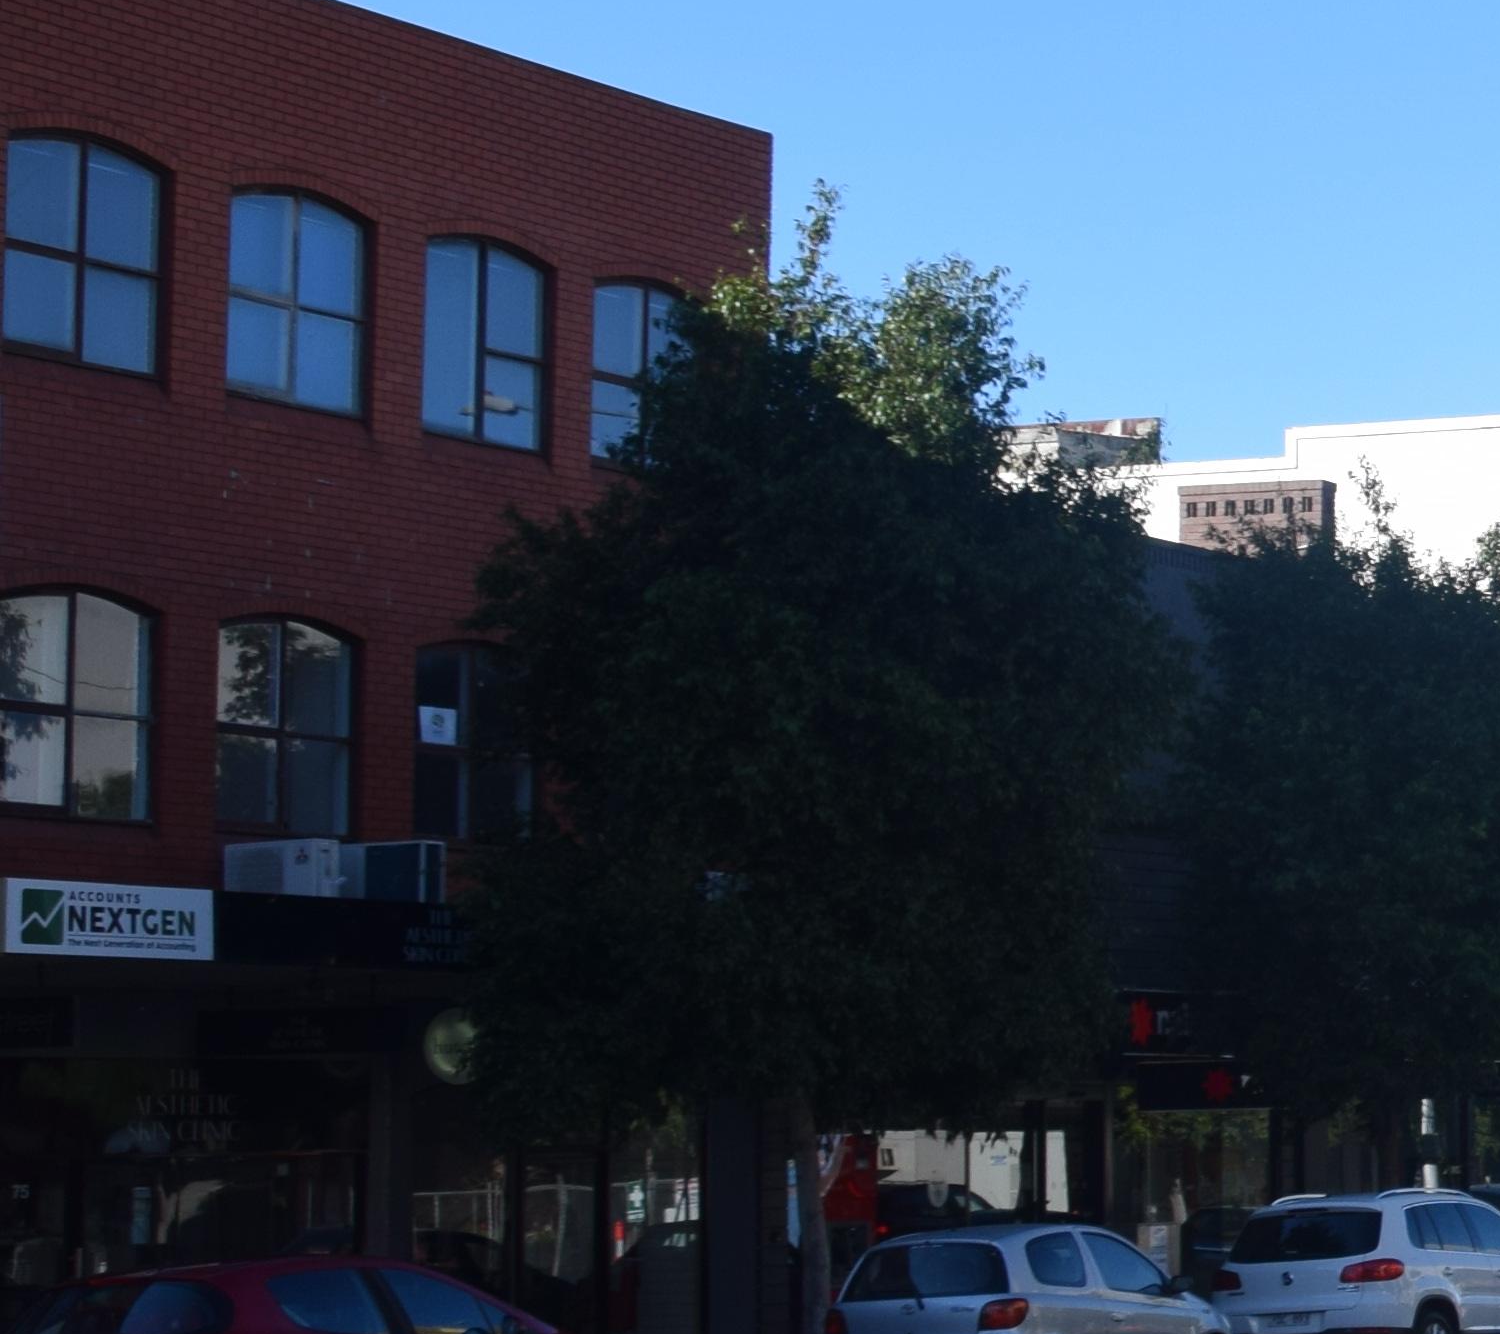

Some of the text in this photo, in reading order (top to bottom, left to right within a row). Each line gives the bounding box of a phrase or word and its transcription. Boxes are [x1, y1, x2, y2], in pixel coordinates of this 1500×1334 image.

[69, 891, 141, 904] ACCOUNTS
[68, 905, 196, 936] NEXTGEN
[69, 938, 82, 946] The
[104, 939, 145, 949] Generation
[134, 1094, 239, 1116] AESTHETIC
[127, 1120, 241, 1142] SKIN CLINIC
[10, 1183, 31, 1200] 75
